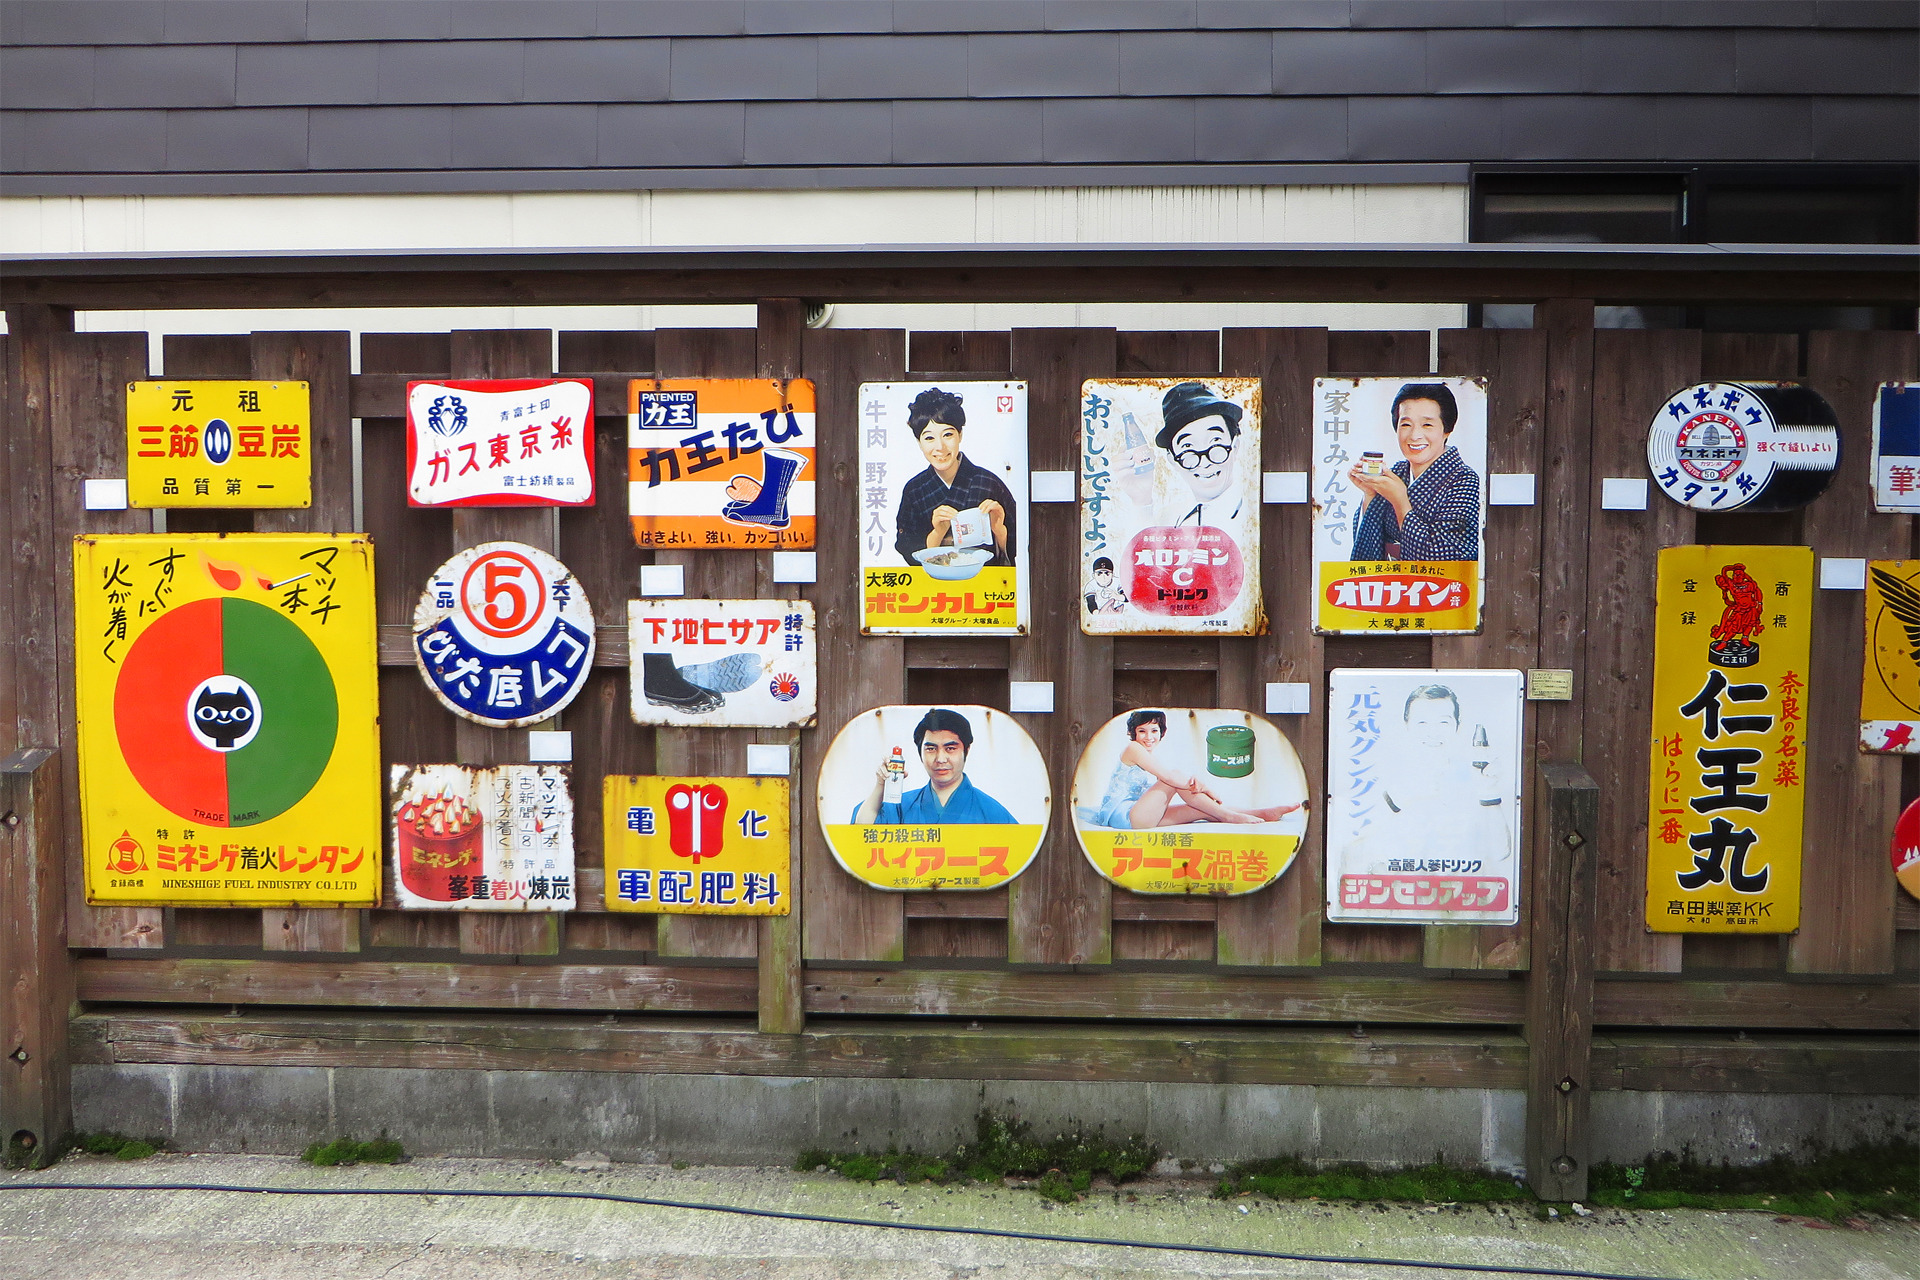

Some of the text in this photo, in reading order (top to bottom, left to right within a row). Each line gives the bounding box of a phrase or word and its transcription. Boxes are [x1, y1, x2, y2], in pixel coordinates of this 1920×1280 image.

[500, 398, 551, 422] 青富士印
[641, 393, 695, 403] PATENTED
[1667, 387, 1763, 427] カネボウ
[644, 403, 694, 426] 力王
[1681, 413, 1742, 437] KANEBO
[237, 424, 301, 458] 豆炭
[427, 415, 573, 487] ガス東京糸
[639, 403, 804, 489] 力王たび
[1680, 448, 1742, 458] カネボウ
[864, 400, 888, 557] 牛肉 野菜入り
[1323, 389, 1351, 546] 家中みんなで
[1704, 470, 1716, 478] 50
[162, 478, 275, 497] 品質第一
[1658, 465, 1759, 506] カタン糸
[1134, 547, 1230, 567] オロナミン
[138, 547, 186, 618] すぐに
[866, 572, 912, 588] 大塚の
[1172, 567, 1194, 586] C
[865, 592, 1015, 614] ボンカレー
[1157, 588, 1209, 601] ドリンク
[1334, 581, 1451, 607] オロナイン
[1681, 578, 1698, 626] 登録
[1772, 581, 1791, 629] 商標
[102, 557, 133, 664] 火が着く
[1368, 617, 1426, 628] 大塚製薬
[784, 614, 804, 653] 特許
[1773, 670, 1805, 788] 奈良の名薬
[1657, 731, 1686, 845] はらに一番
[1675, 669, 1776, 894] 仁王丸
[541, 778, 556, 819] マッチ
[192, 808, 261, 823] TRADE MARK
[156, 828, 196, 840] 特許
[863, 828, 941, 844] 強力殺虫剤
[1113, 832, 1194, 848] かとり線香
[157, 843, 364, 875] ミネシゲ着火レンタン
[412, 846, 473, 869] ミネシゲ
[866, 846, 1010, 877] ハイアース
[1111, 847, 1269, 882] アース渦巻
[162, 879, 222, 890] MINESHIGE
[223, 879, 255, 890] FUEL
[256, 879, 312, 891] INDUSTRY
[617, 869, 782, 905] 軍配肥料
[1344, 878, 1506, 907] ジンセンアップ
